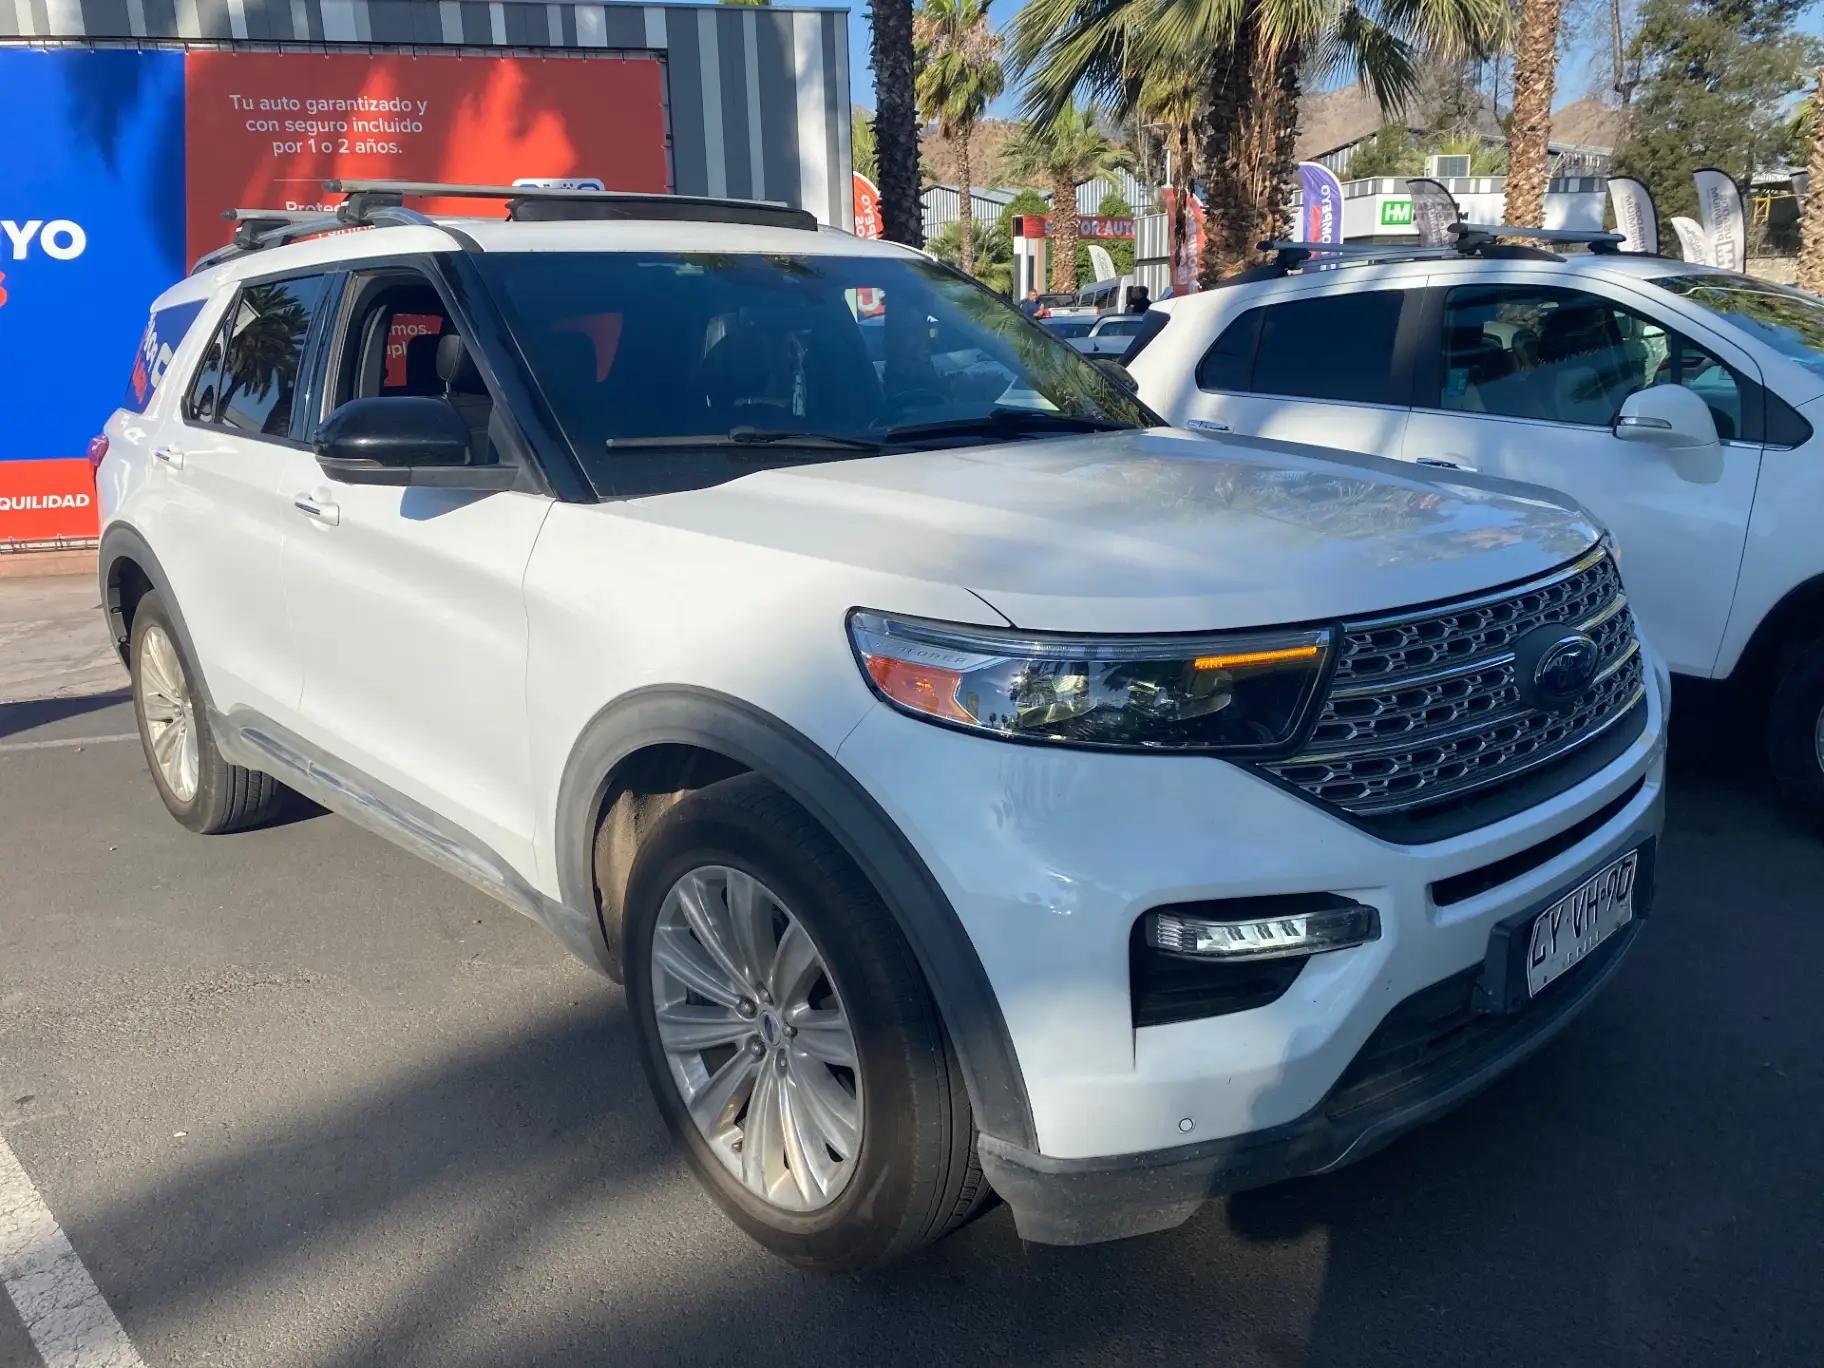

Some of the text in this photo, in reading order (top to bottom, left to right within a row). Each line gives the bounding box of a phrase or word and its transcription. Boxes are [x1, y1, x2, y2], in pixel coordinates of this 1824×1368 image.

[229, 95, 427, 115] Tu auto garantizado y
[246, 117, 422, 135] con seguro incluido
[273, 139, 402, 156] por 1 o 2 años.
[1384, 204, 1411, 221] HM
[1044, 221, 1101, 235] SOR
